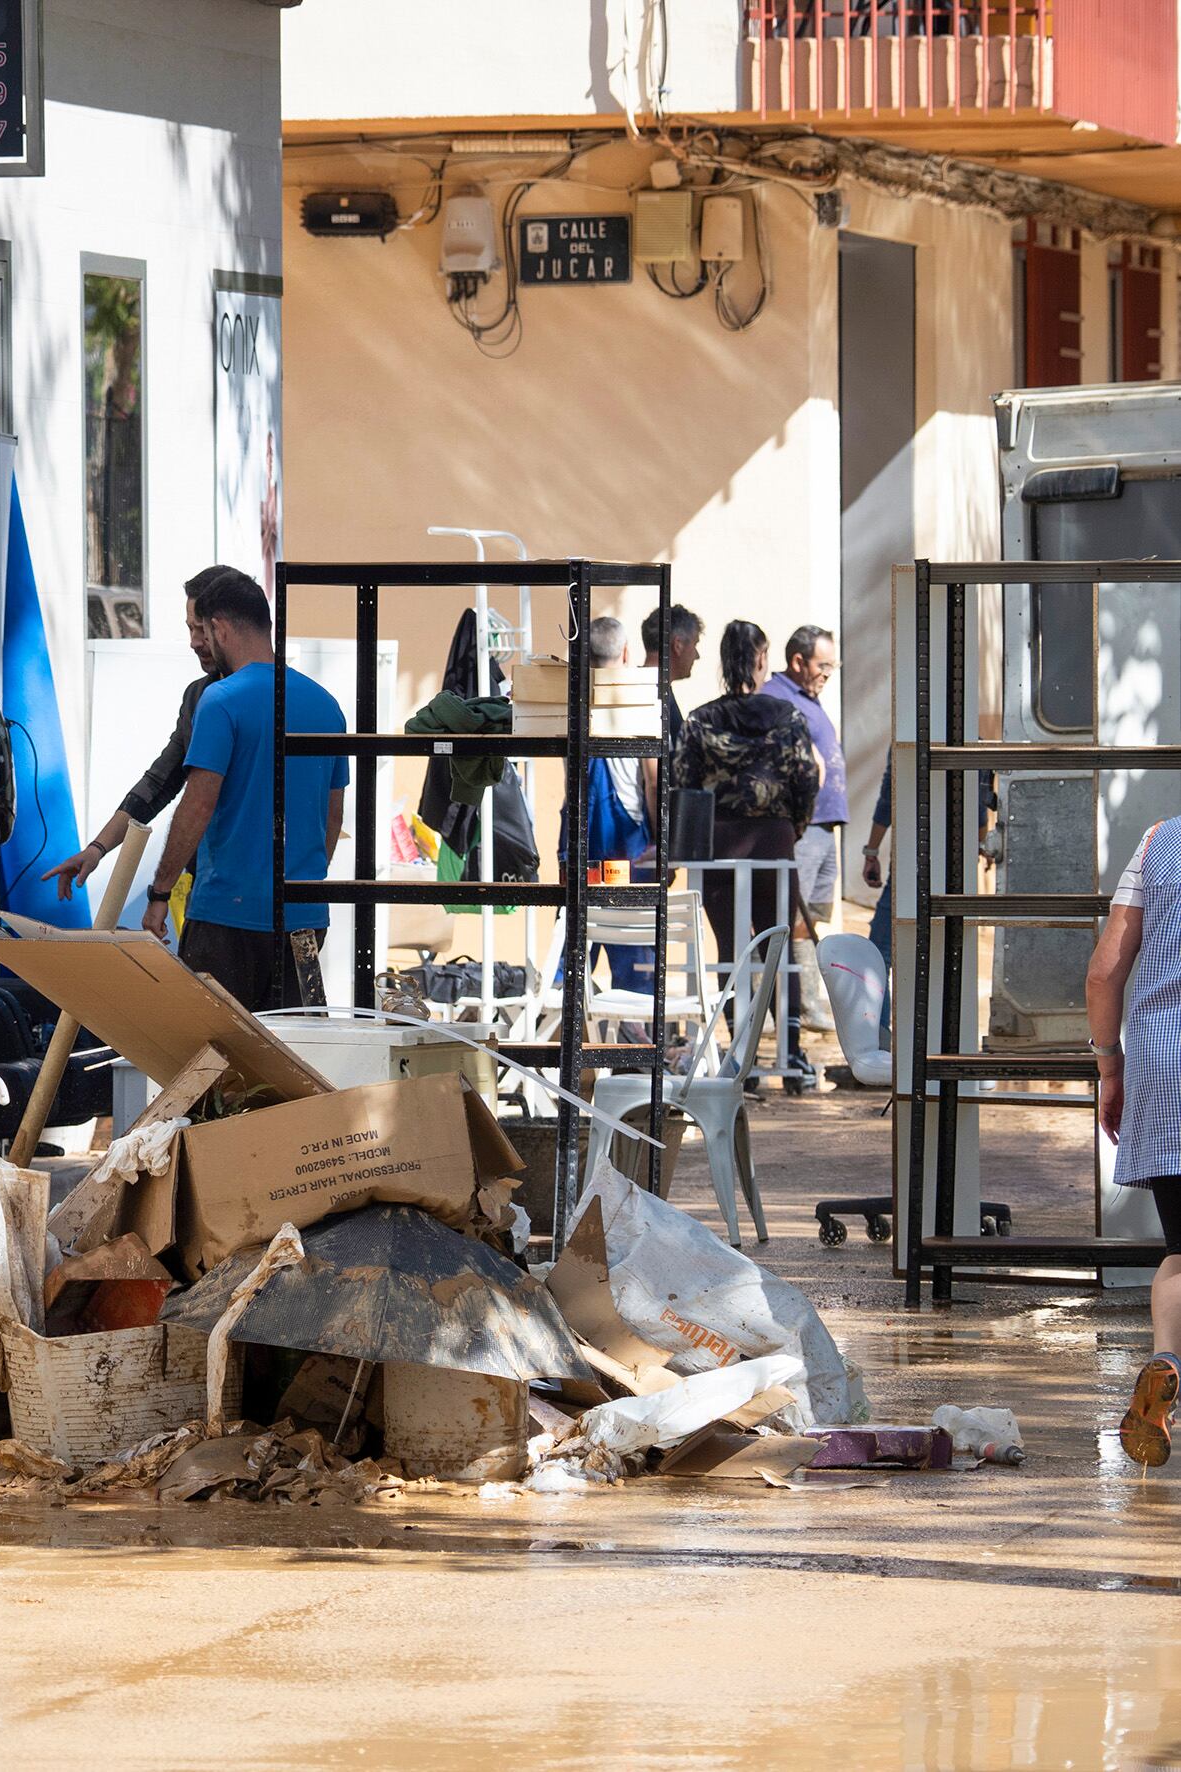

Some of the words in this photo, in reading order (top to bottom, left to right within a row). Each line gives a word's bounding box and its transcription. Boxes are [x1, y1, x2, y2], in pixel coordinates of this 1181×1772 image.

[559, 221, 607, 239] CALLE
[569, 242, 595, 254] DEL
[536, 256, 614, 279] JUCAR
[331, 1136, 343, 1149] IN
[345, 1129, 379, 1143] MADE
[339, 1160, 421, 1182] PROFESSIONAL
[310, 1177, 337, 1191] HAIR
